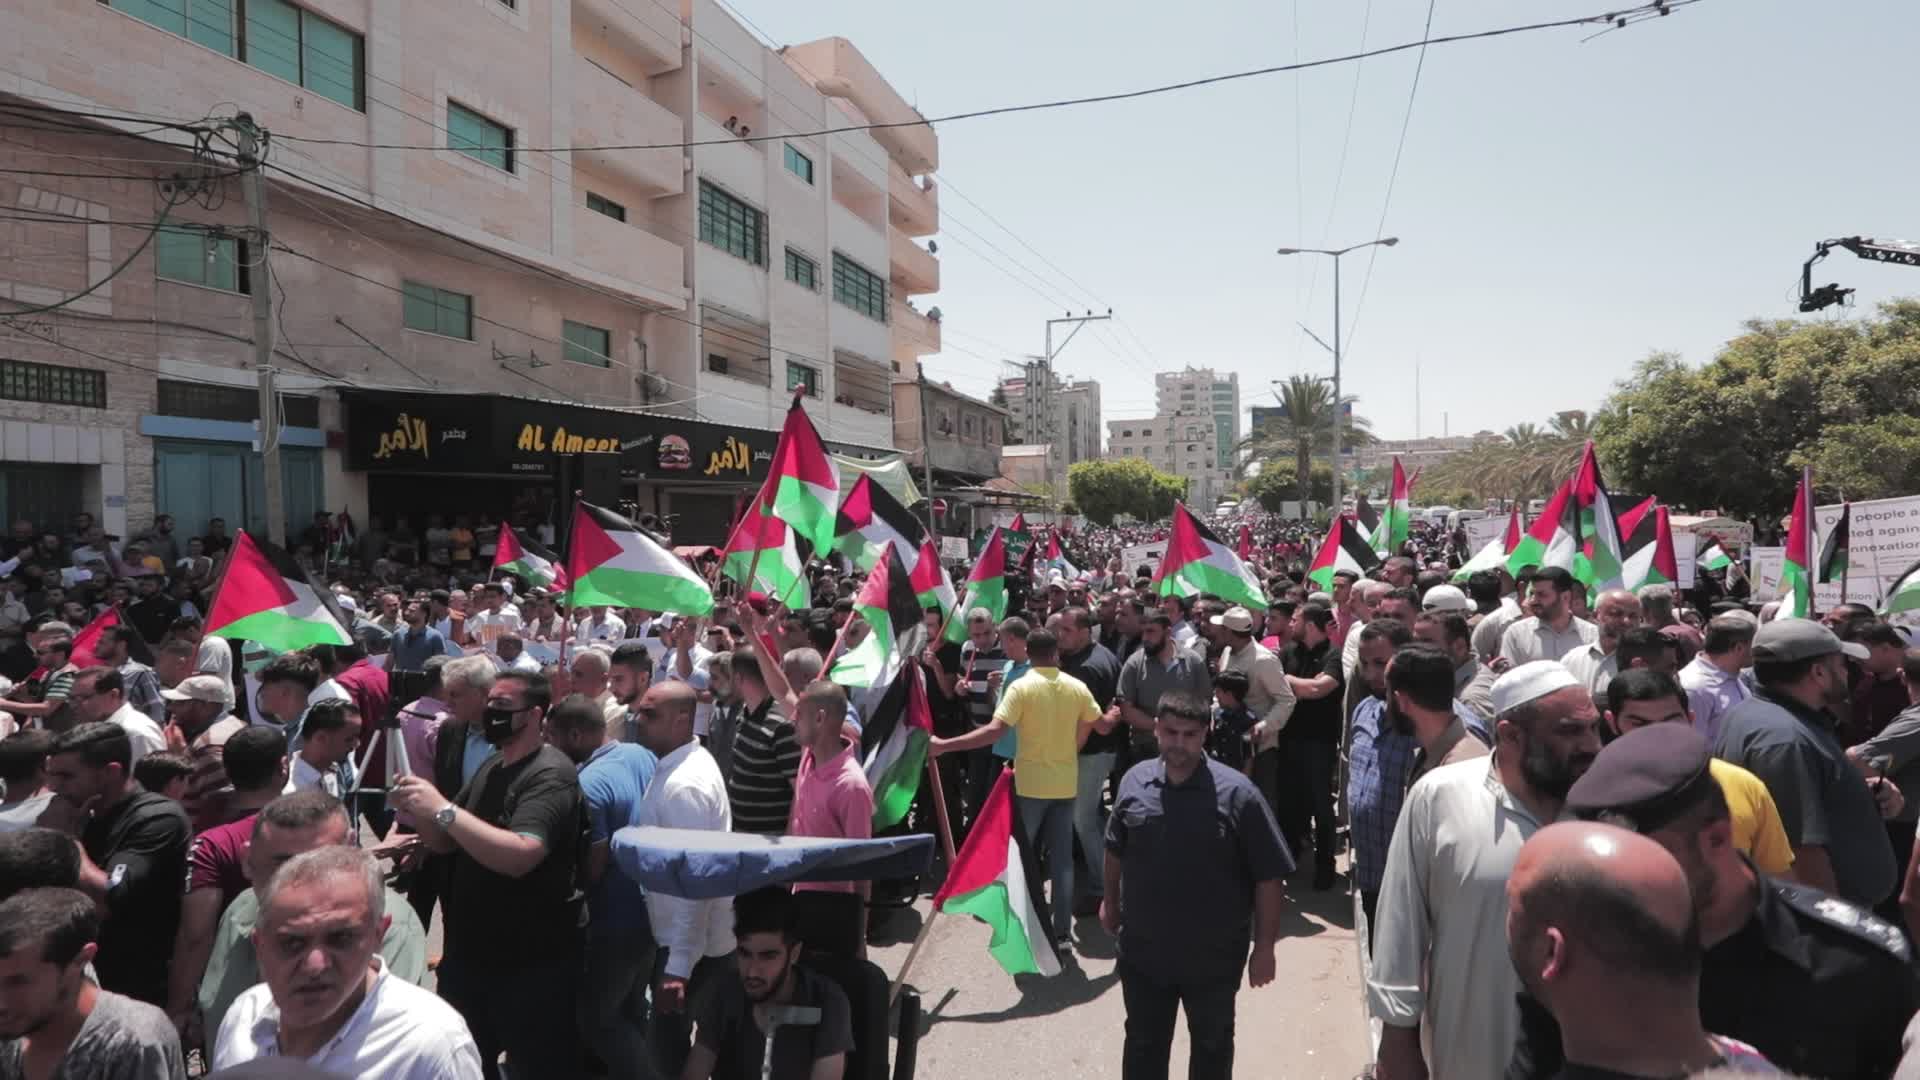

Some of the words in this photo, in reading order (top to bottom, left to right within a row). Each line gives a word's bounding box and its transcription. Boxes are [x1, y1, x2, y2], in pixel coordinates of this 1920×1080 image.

[372, 412, 428, 460] الأمير
[551, 426, 620, 453] Ameer
[703, 435, 750, 476] الأمير
[1855, 509, 1906, 523] people
[1878, 525, 1920, 537] again
